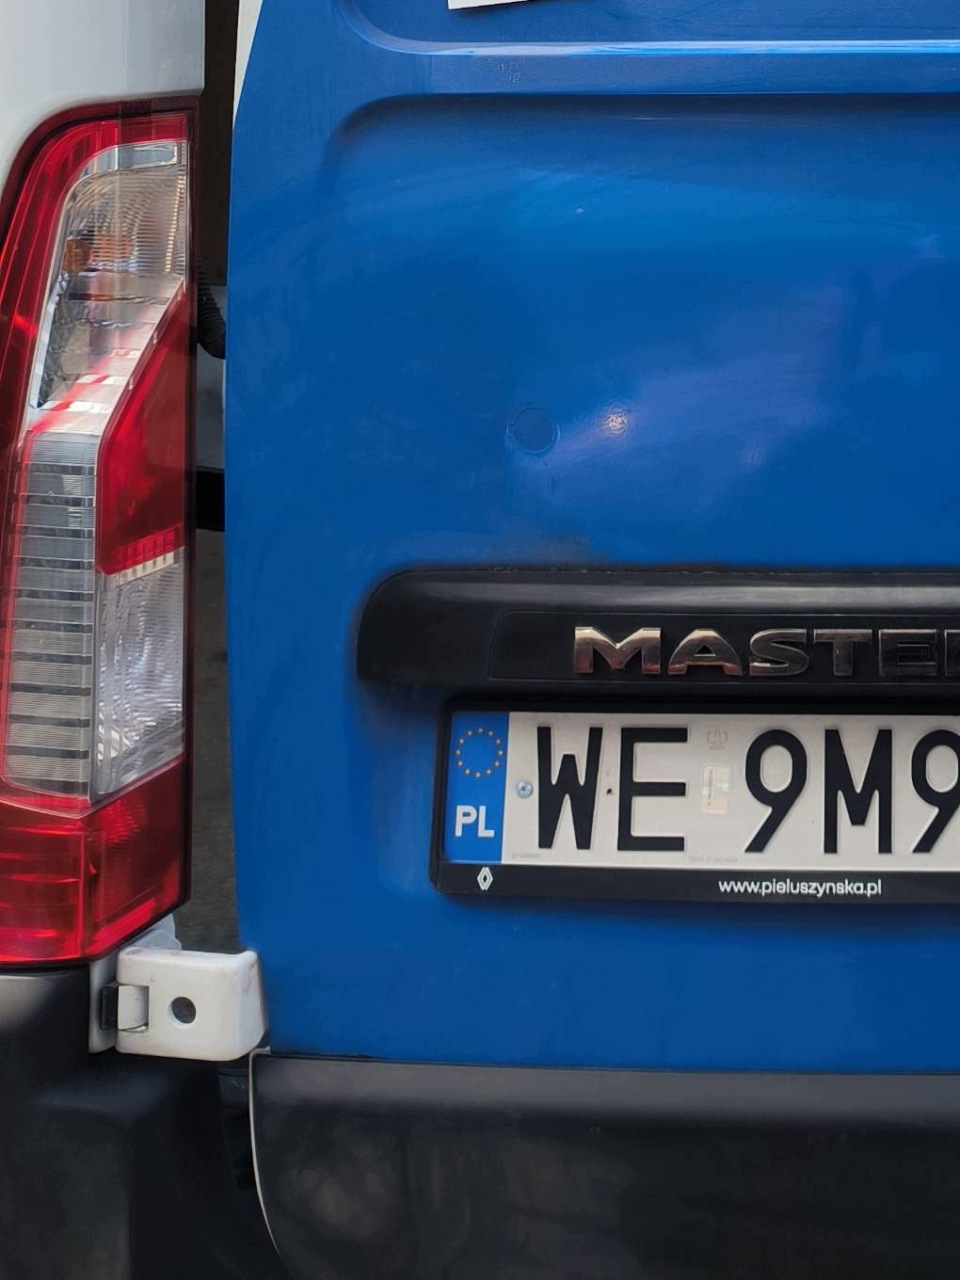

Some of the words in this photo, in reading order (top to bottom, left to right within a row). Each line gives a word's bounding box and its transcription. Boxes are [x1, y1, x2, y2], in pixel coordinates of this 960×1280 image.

[536, 725, 689, 852] WE
[454, 805, 495, 839] PL
[718, 878, 882, 898] www.pieluszynska.pl
